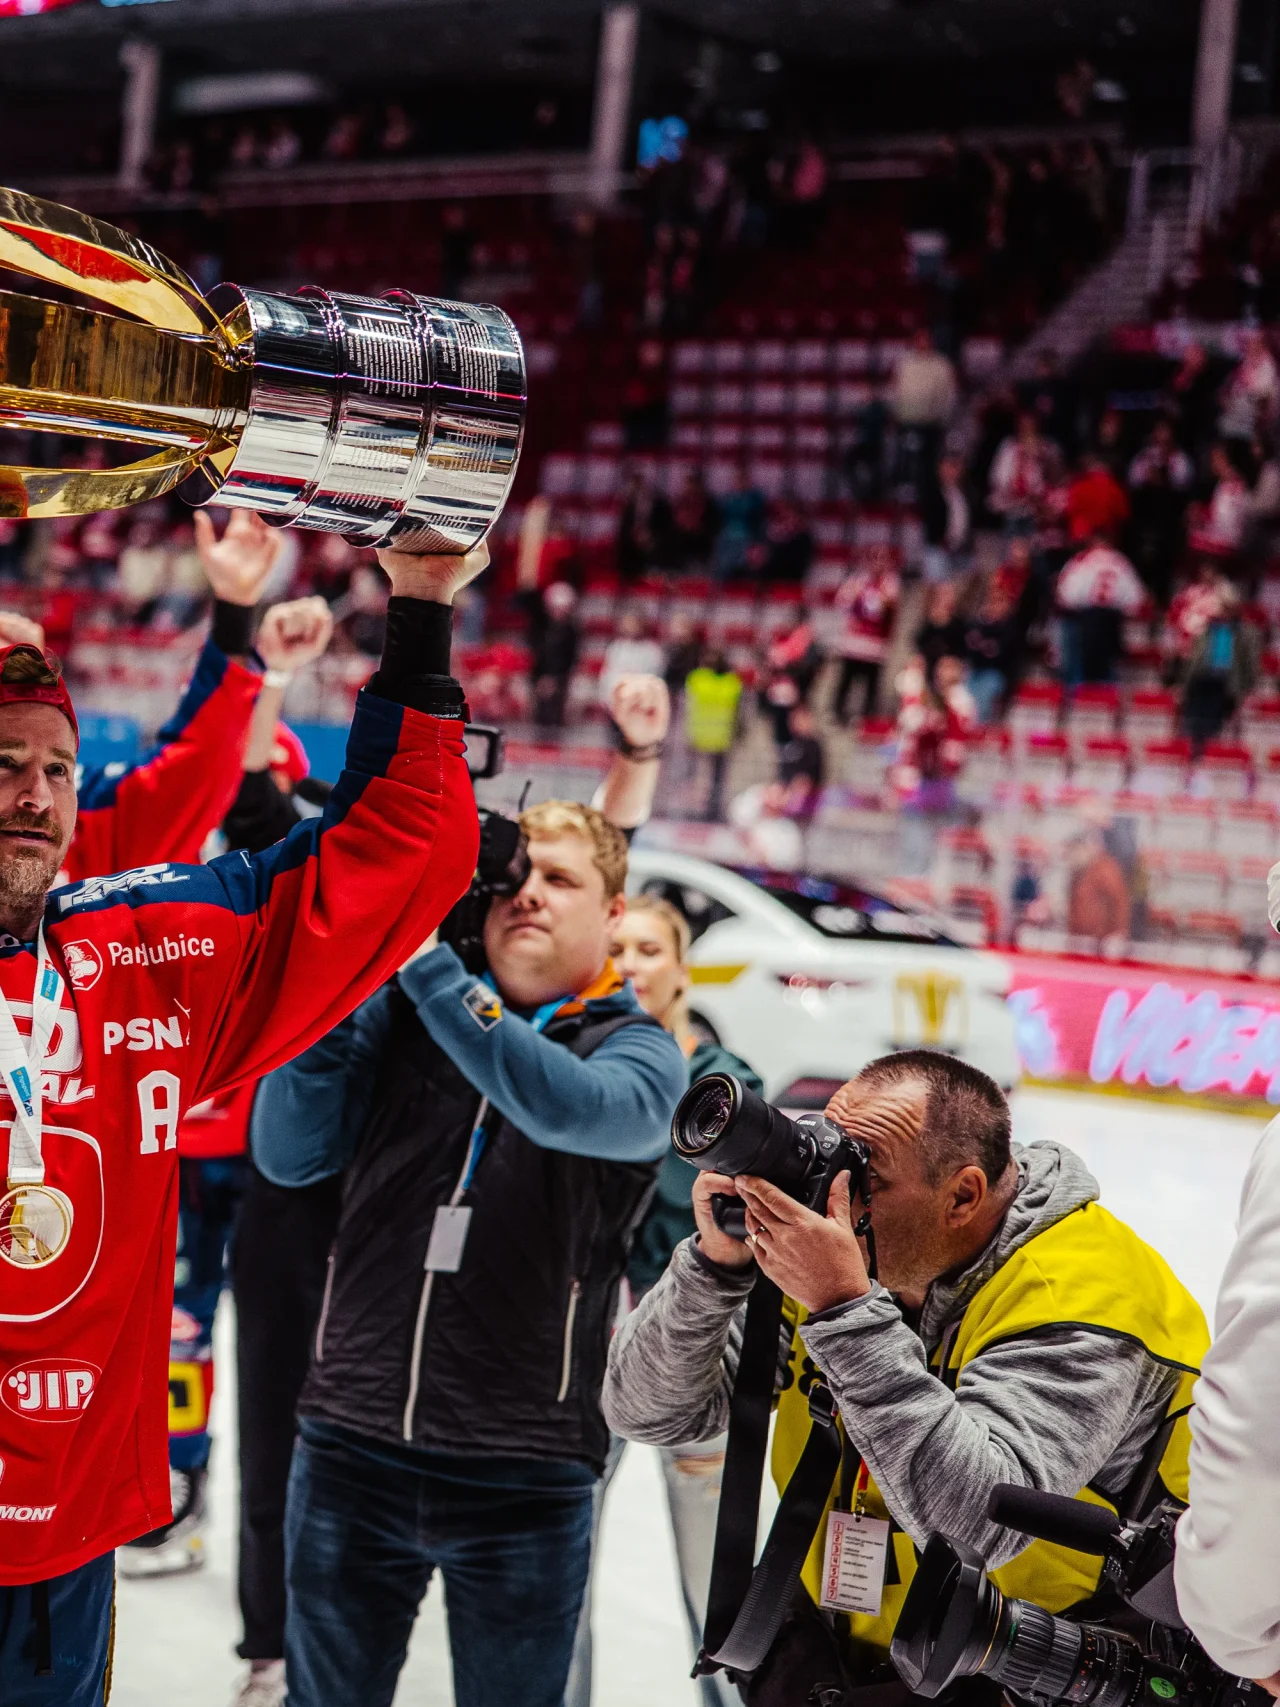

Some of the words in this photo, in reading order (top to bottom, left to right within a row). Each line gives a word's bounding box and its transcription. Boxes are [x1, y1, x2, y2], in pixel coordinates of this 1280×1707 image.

[104, 1016, 184, 1055] PSN
[137, 1070, 181, 1155] A
[19, 1370, 94, 1410] JIP
